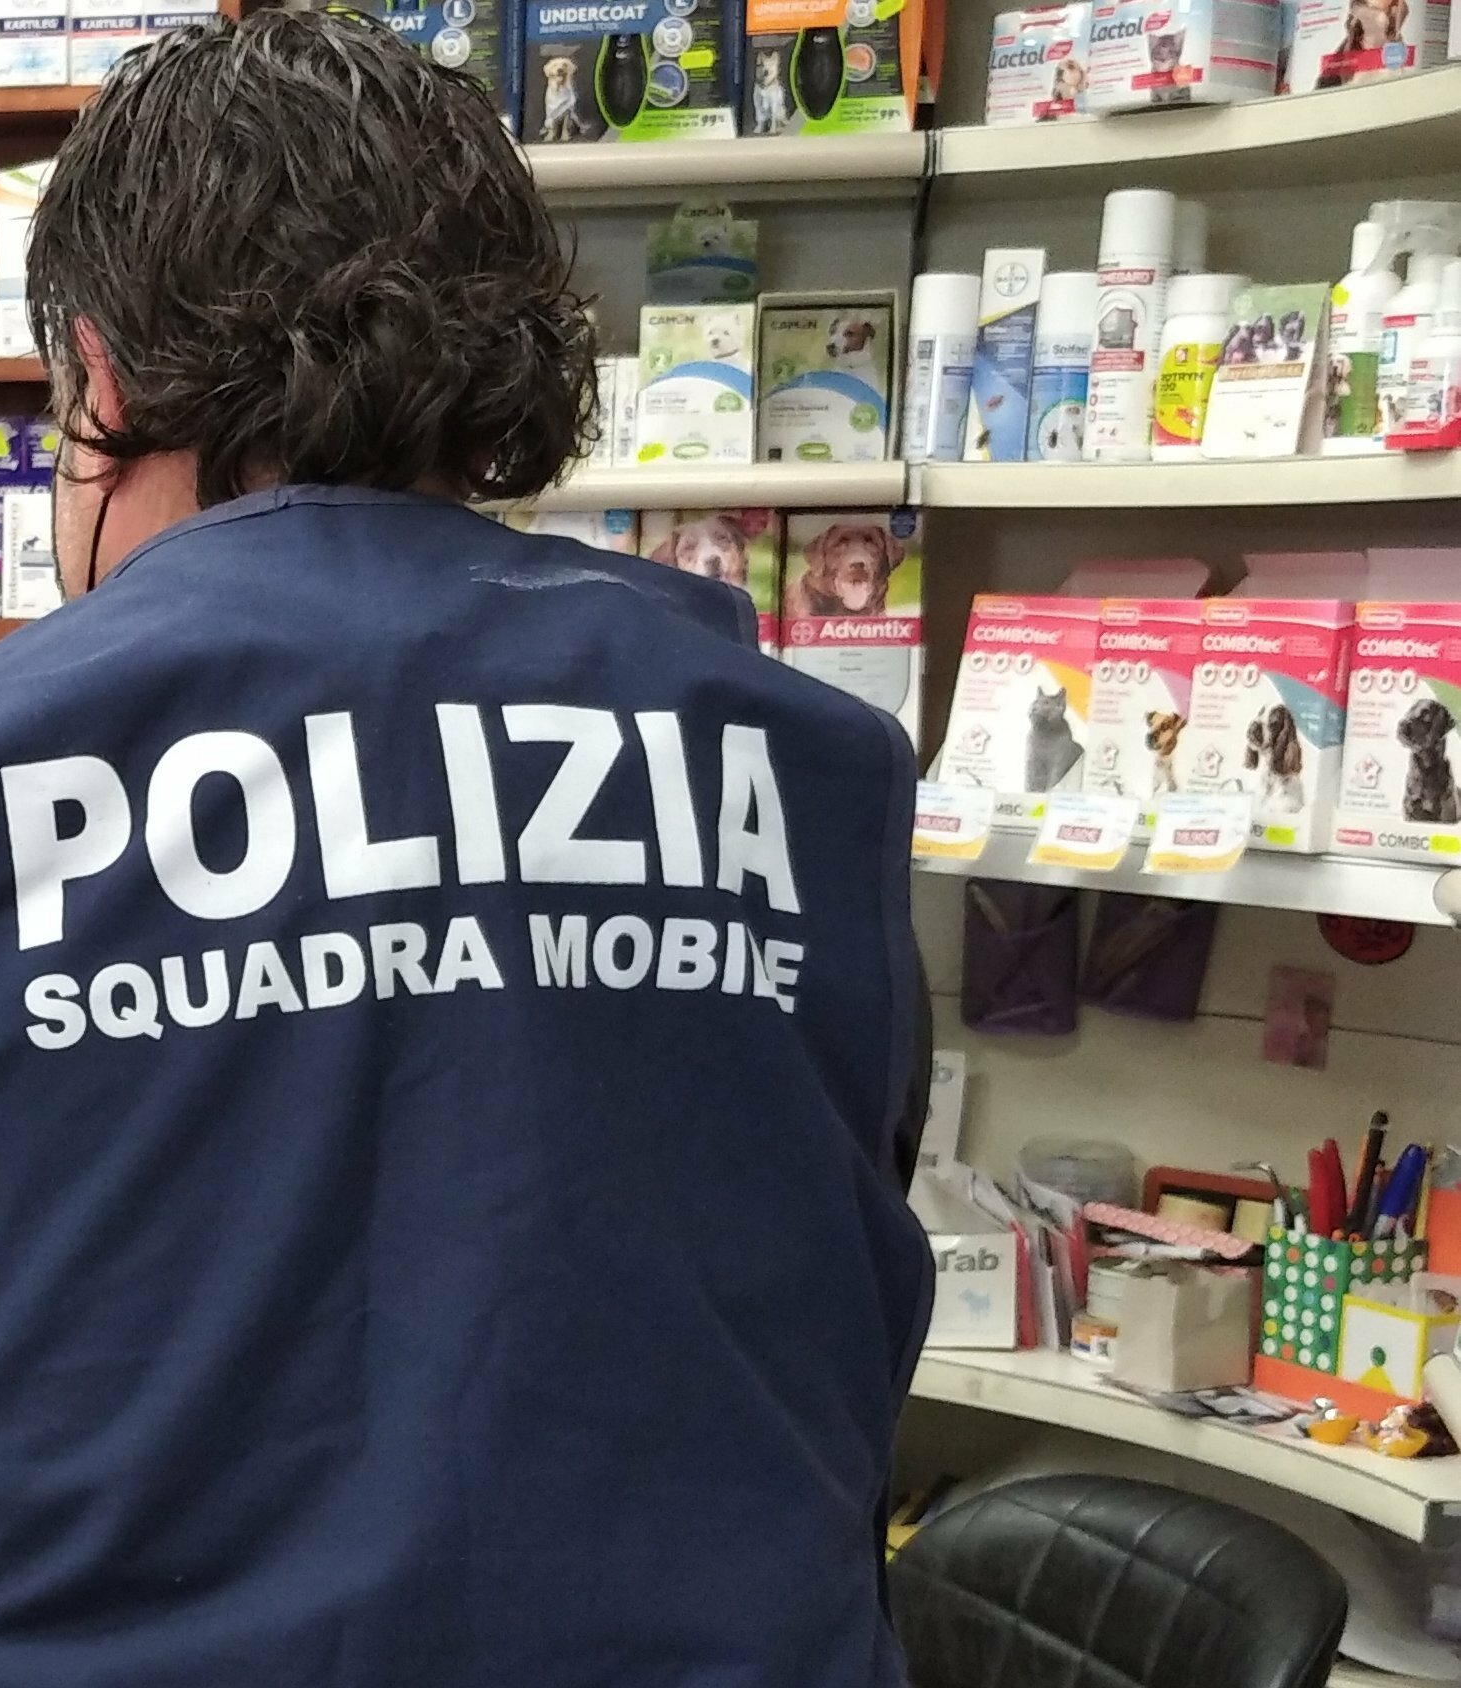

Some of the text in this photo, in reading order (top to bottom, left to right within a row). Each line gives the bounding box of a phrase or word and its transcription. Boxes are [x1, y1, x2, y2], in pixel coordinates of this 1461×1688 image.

[539, 5, 647, 25] UNDERCOAT
[1089, 15, 1145, 42] Lactol
[989, 44, 1045, 70] Lactol
[819, 619, 914, 640] Advantix
[0, 703, 801, 952] POLIZIA
[1378, 833, 1431, 850] COMBO
[23, 913, 805, 1051] SQUADRA MOBILE
[936, 1247, 1000, 1273] Tab
